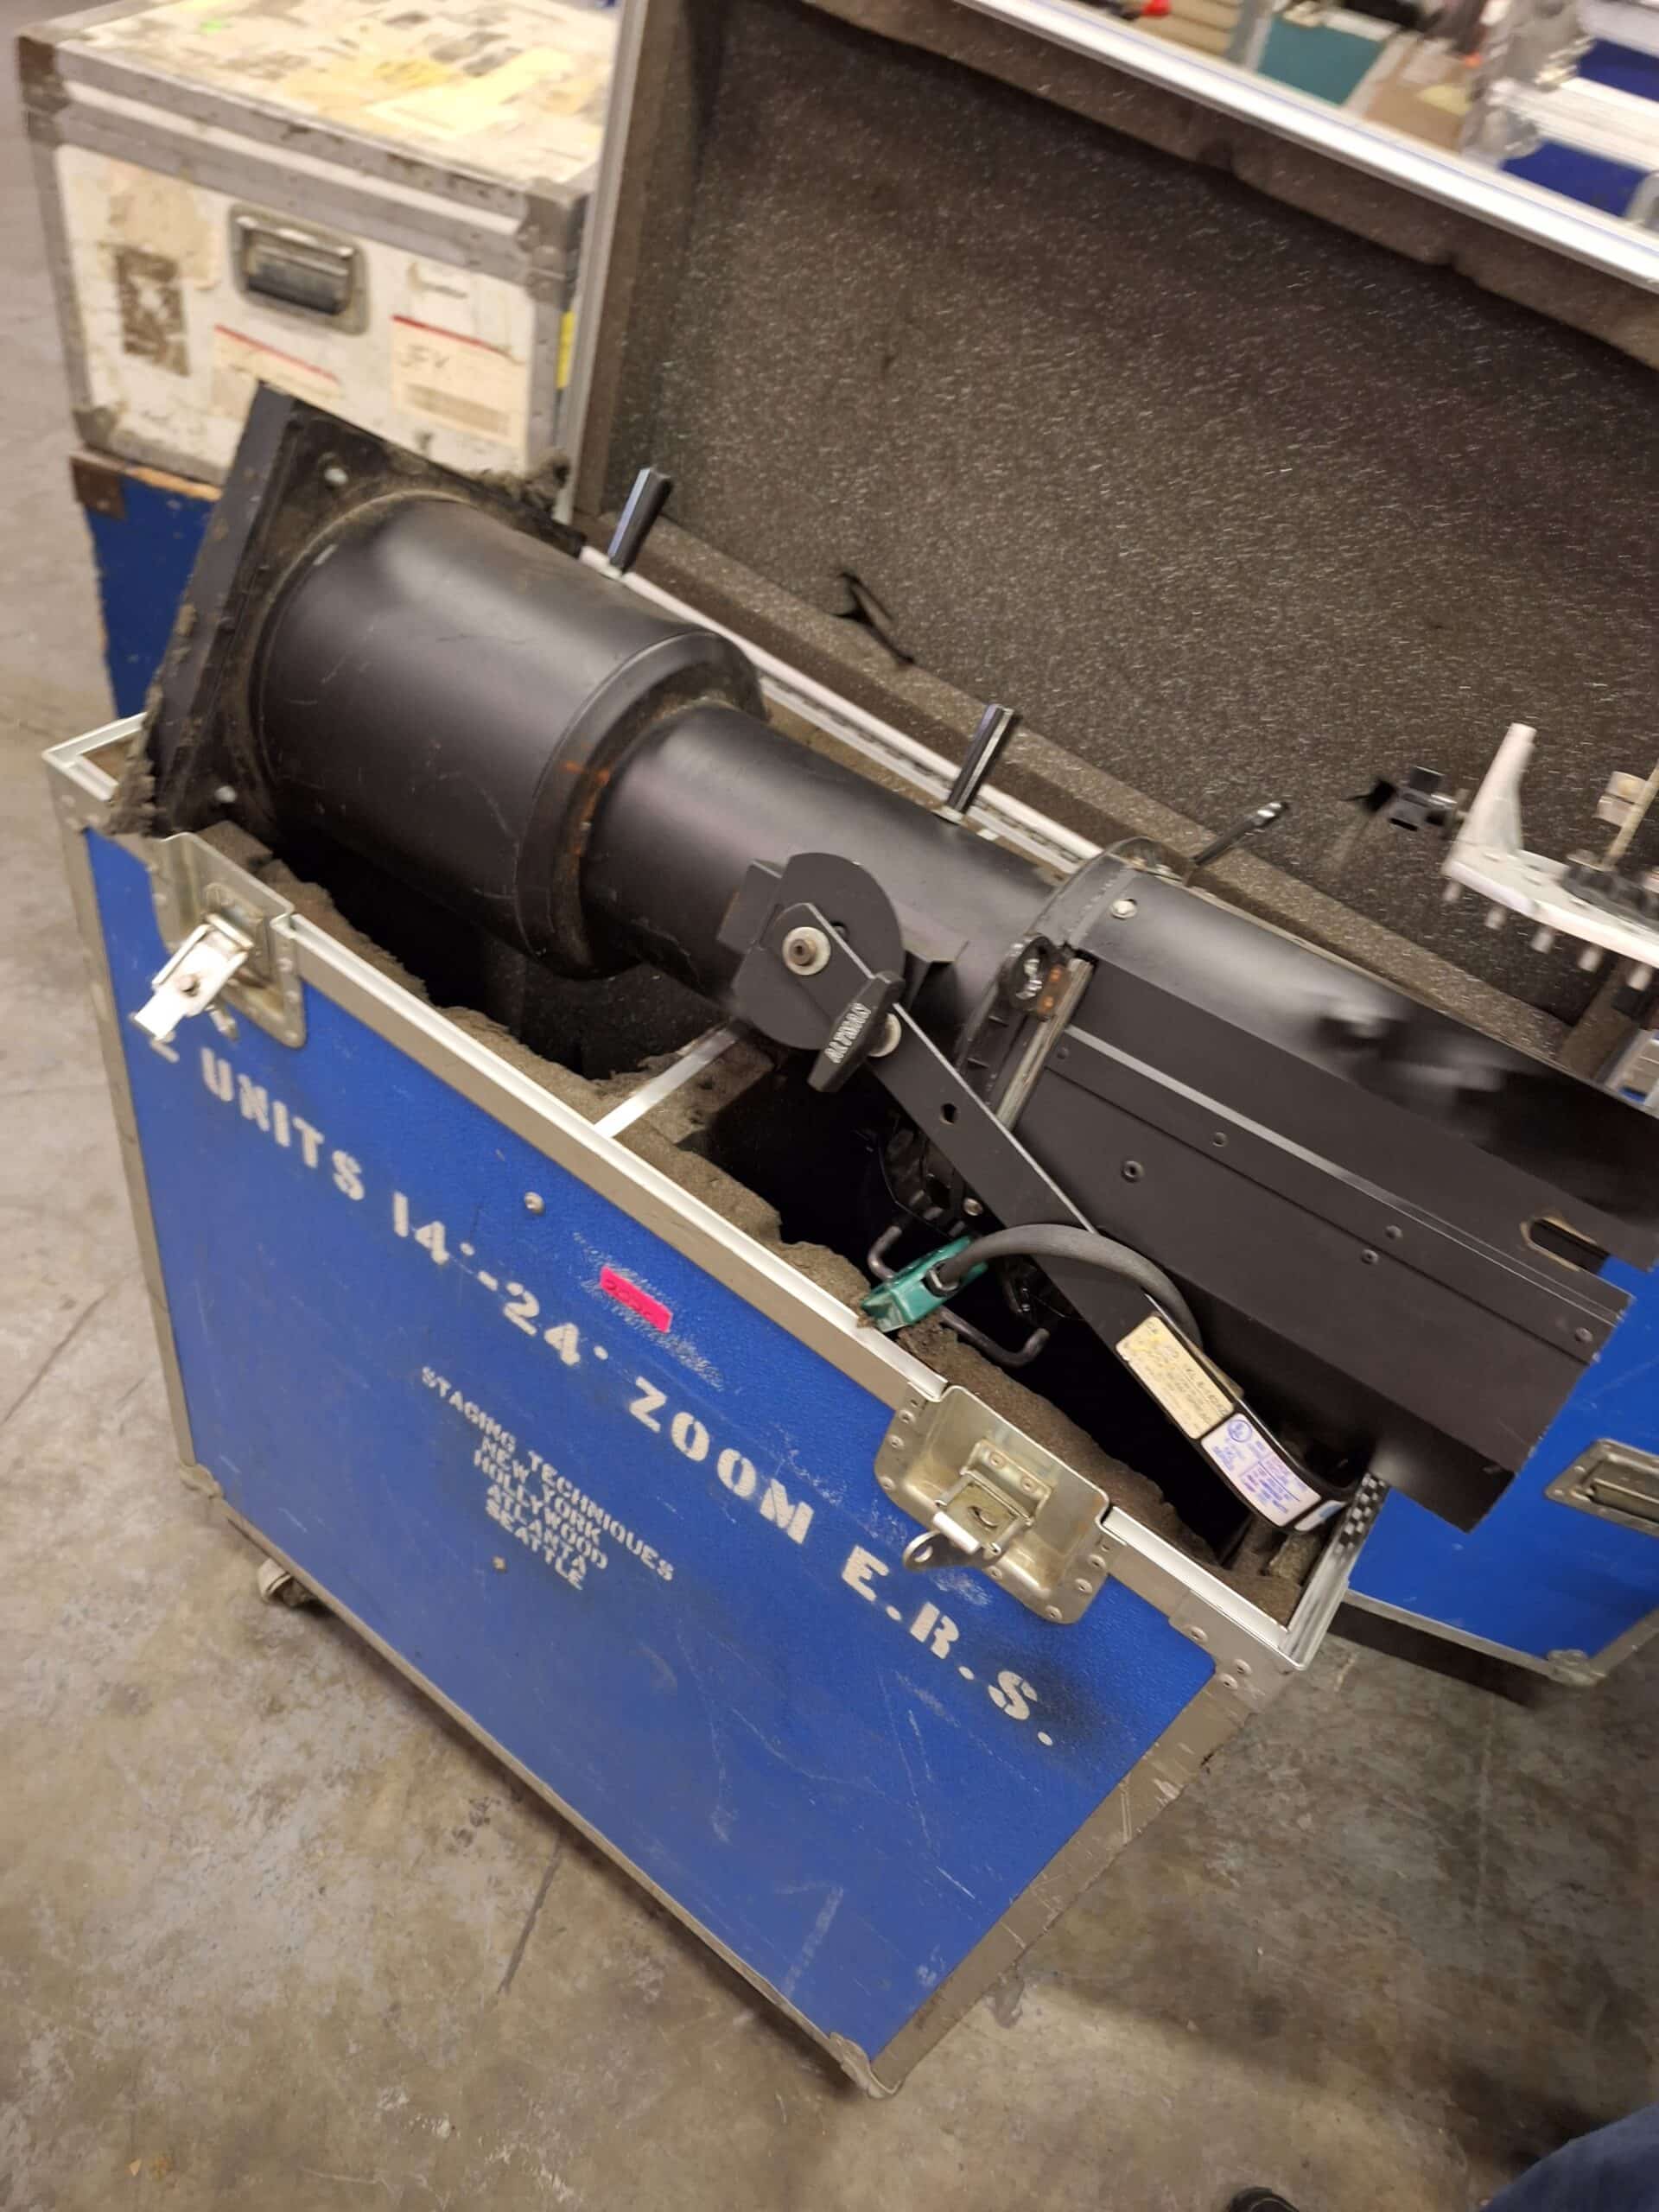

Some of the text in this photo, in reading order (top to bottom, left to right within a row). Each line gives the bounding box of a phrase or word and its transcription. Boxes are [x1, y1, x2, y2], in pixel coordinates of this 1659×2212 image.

[200, 1046, 365, 1200] UNITS
[630, 1376, 814, 1545] ZOOM
[422, 1366, 674, 1581] STAGING TECHNIQUES
[474, 1449, 608, 1569] HOLLYWOOD
[481, 1436, 602, 1546] NEW YORK
[486, 1484, 587, 1576] ATLANTA
[485, 1500, 583, 1591] SEATTLE
